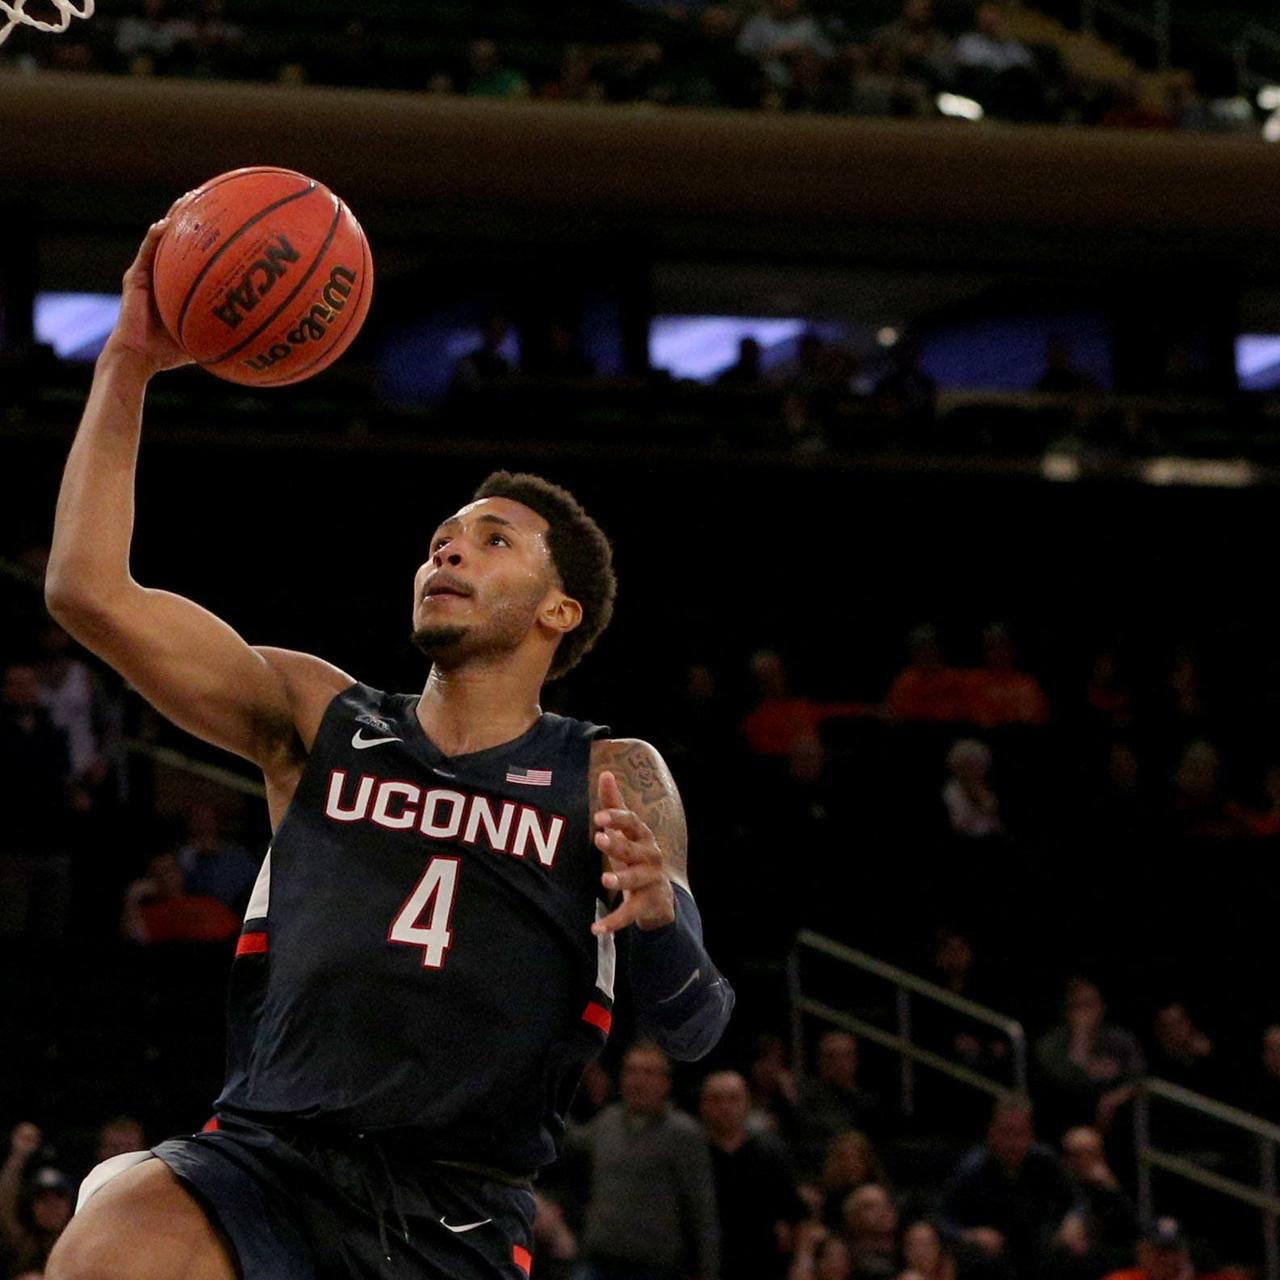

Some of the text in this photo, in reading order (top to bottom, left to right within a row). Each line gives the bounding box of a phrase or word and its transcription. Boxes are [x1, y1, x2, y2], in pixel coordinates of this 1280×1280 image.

[212, 233, 301, 330] NCAA
[244, 264, 358, 373] Wilson
[325, 770, 567, 867] UCONN
[388, 856, 461, 969] 4
